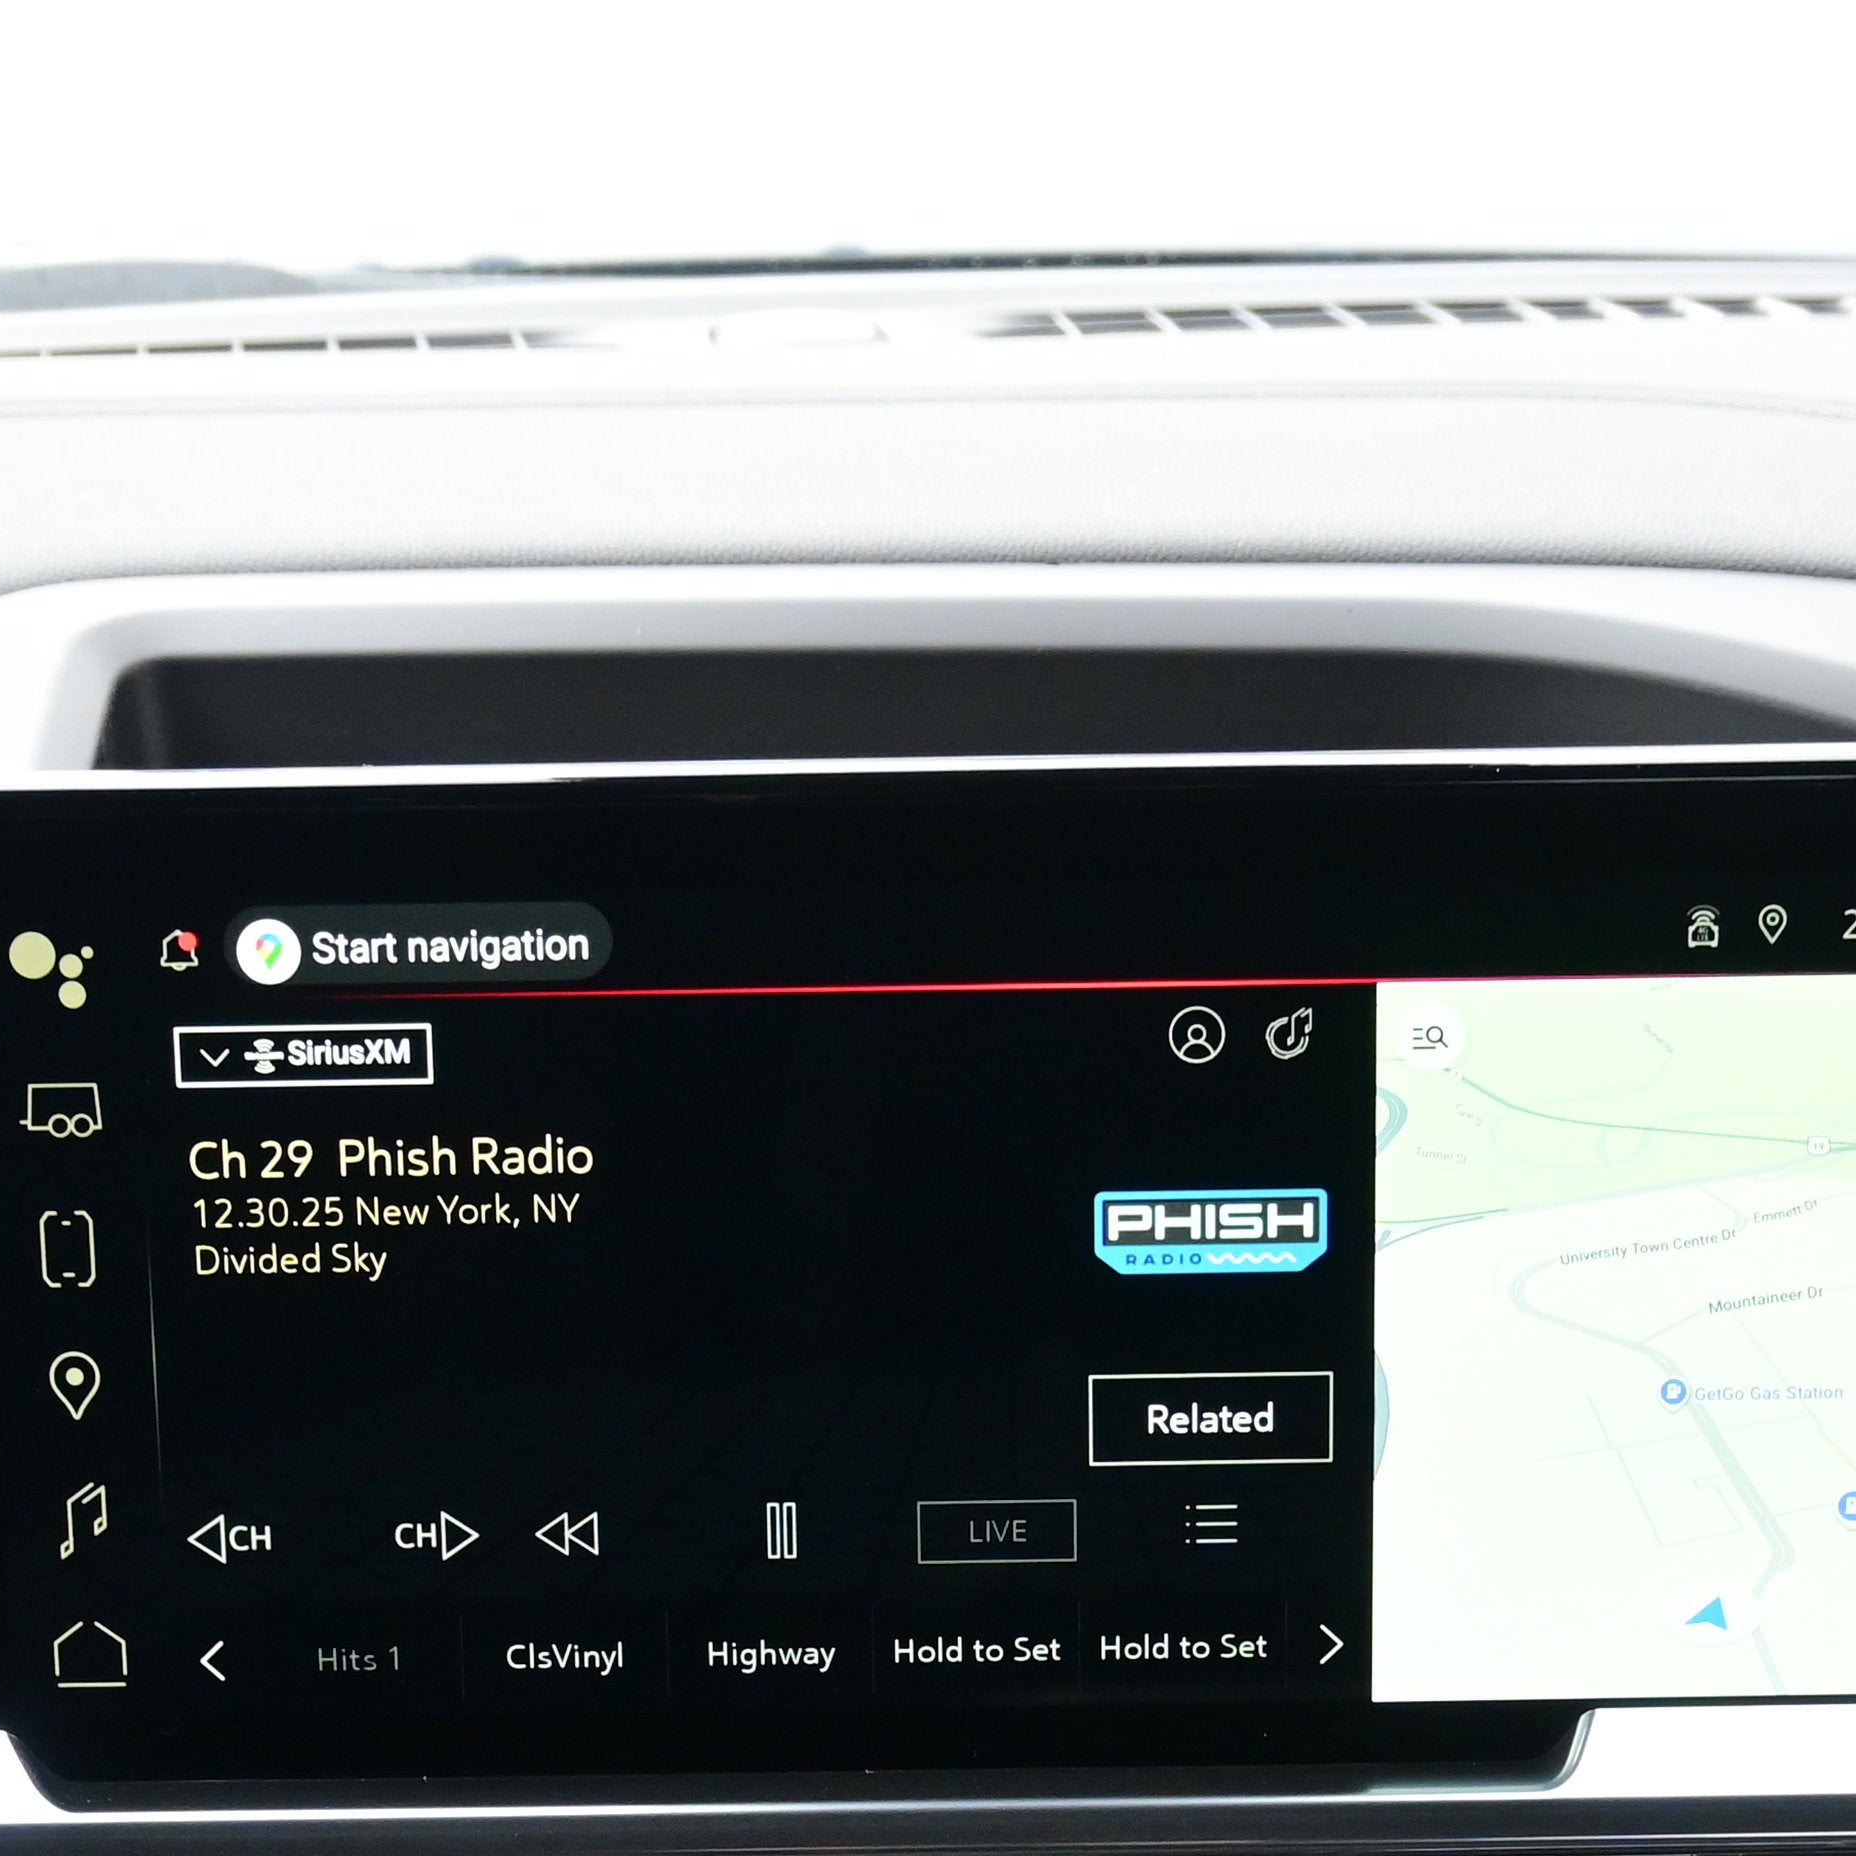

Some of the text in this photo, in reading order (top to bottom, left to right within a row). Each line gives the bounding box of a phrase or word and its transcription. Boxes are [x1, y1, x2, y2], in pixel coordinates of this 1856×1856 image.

[312, 927, 590, 970] Start navigation
[286, 1037, 412, 1067] SiriusXM
[189, 1133, 594, 1180] Ch 29 Phish Radio
[193, 1192, 580, 1229] 12.30.25 New York, NY
[1106, 1202, 1315, 1241] PHISH
[1753, 1199, 1818, 1224] Emmett Dr
[195, 1241, 387, 1282] Divided Sky
[1125, 1253, 1202, 1266] RADIO
[1559, 1229, 1736, 1266] University Town Centre Dr
[1708, 1286, 1823, 1315] Mountaineer Dr
[1694, 1385, 1844, 1401] GetGo Gas Station
[1147, 1400, 1274, 1435] Related
[228, 1525, 272, 1552] CH
[394, 1522, 438, 1549] CH
[969, 1519, 1027, 1543] LIVE
[318, 1645, 399, 1672] Hits 1
[506, 1641, 623, 1676] ClsVinyl
[708, 1639, 836, 1674] Highway
[894, 1636, 1061, 1664] Hold to Set
[1100, 1632, 1268, 1661] Hold to Set
